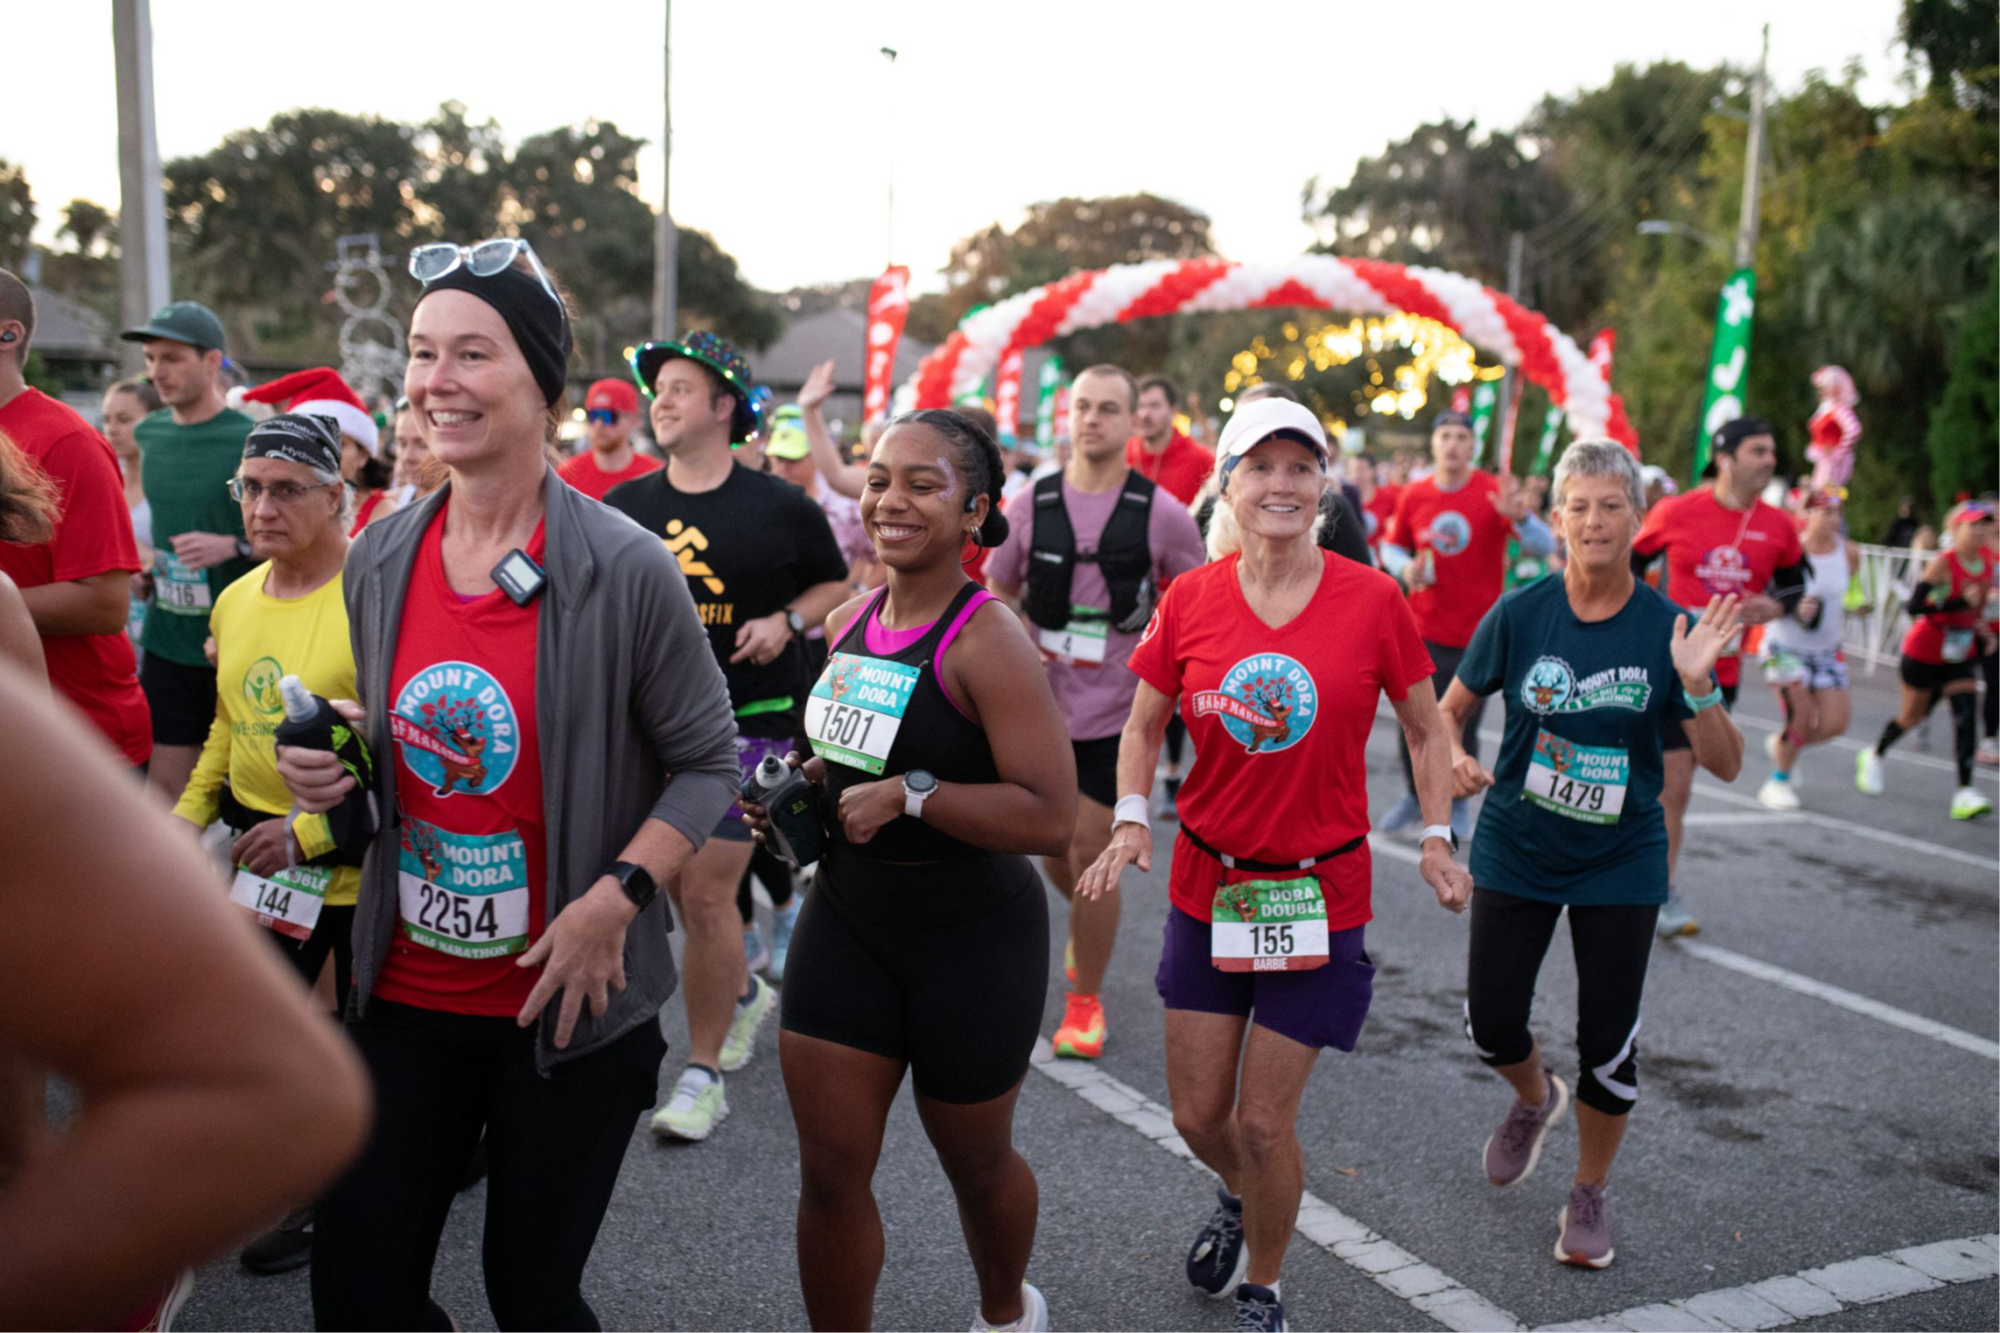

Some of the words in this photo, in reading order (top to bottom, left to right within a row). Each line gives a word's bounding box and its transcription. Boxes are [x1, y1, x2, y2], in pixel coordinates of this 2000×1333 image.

[694, 603, 733, 625] SFIX
[858, 666, 918, 692] MOUNT
[1225, 658, 1286, 694] MOUNT
[1287, 668, 1313, 717] DORA
[1577, 668, 1616, 693] MOUNT
[1619, 666, 1648, 682] DORA
[858, 685, 897, 708] DORA
[400, 669, 479, 717] MOUNT
[478, 686, 512, 753] DORA
[1198, 694, 1228, 713] HALF
[1229, 701, 1277, 727] MARATHON
[391, 716, 406, 736] LF
[819, 703, 875, 750] 1501
[1576, 752, 1628, 767] MOUNT
[1581, 766, 1620, 780] DORA
[1549, 773, 1605, 812] 1479
[1558, 805, 1605, 824] MARATHON
[442, 840, 523, 866] MOUNT
[453, 864, 514, 887] DORA
[256, 882, 292, 918] 144
[1269, 886, 1315, 902] DORA
[419, 883, 498, 939] 2254
[1261, 899, 1325, 917] DOUBLE
[411, 931, 436, 946] HALF
[438, 941, 508, 958] MARATHON
[1249, 924, 1294, 955] 155
[1253, 957, 1288, 970] BARBIE
